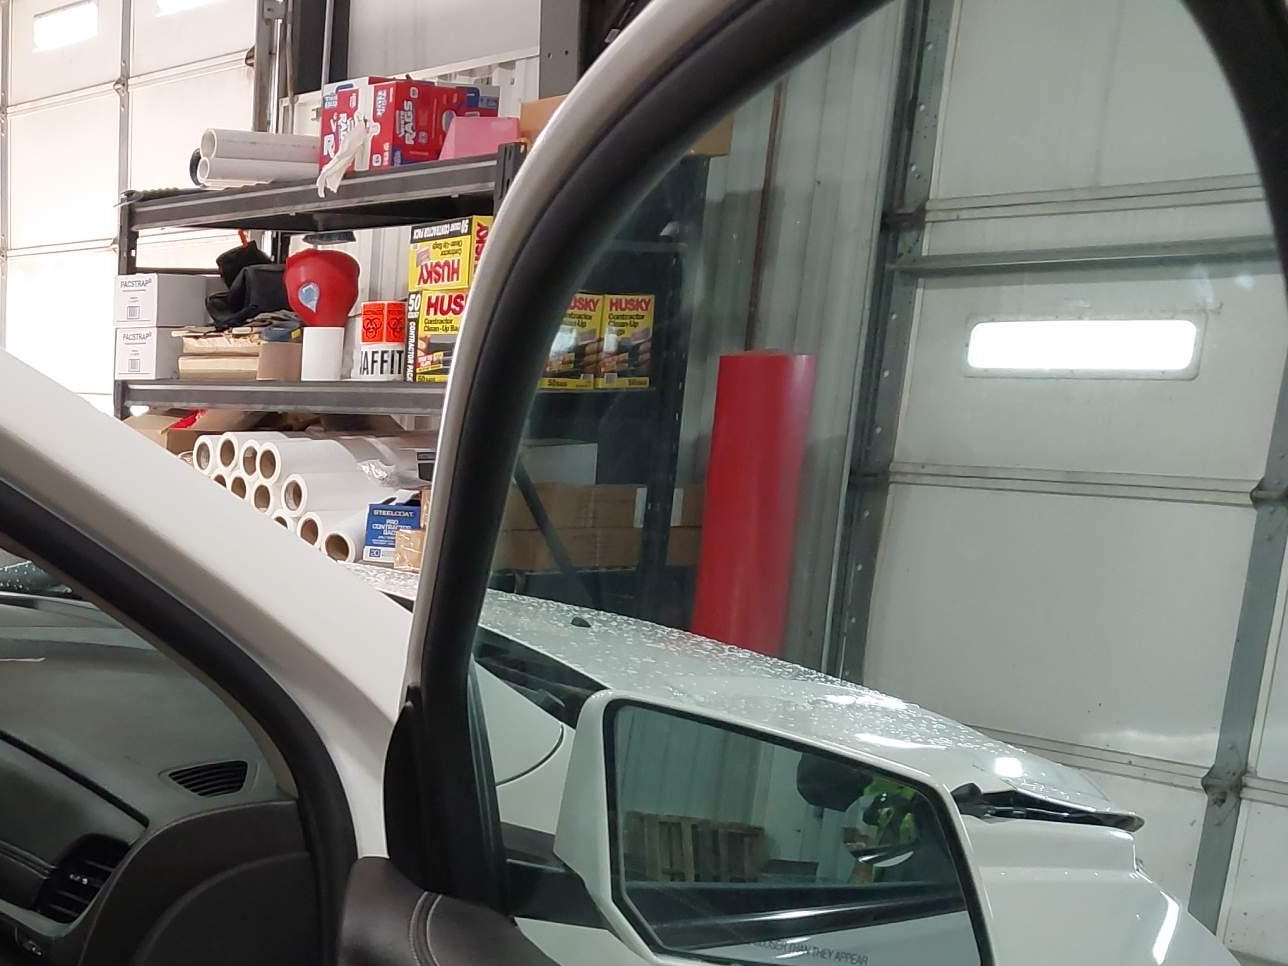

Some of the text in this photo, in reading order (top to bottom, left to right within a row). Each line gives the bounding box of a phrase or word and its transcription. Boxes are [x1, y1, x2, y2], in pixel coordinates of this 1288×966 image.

[404, 100, 416, 145] RAGS
[418, 259, 460, 285] HUSKY
[408, 294, 421, 312] 50
[426, 294, 467, 316] HUS
[568, 298, 599, 312] USKY
[609, 298, 651, 311] HUSKY
[408, 321, 416, 364] CONTRACTOR
[360, 350, 404, 375] AFFIT
[811, 946, 833, 960] THEY
[834, 951, 868, 966] APPEAR
